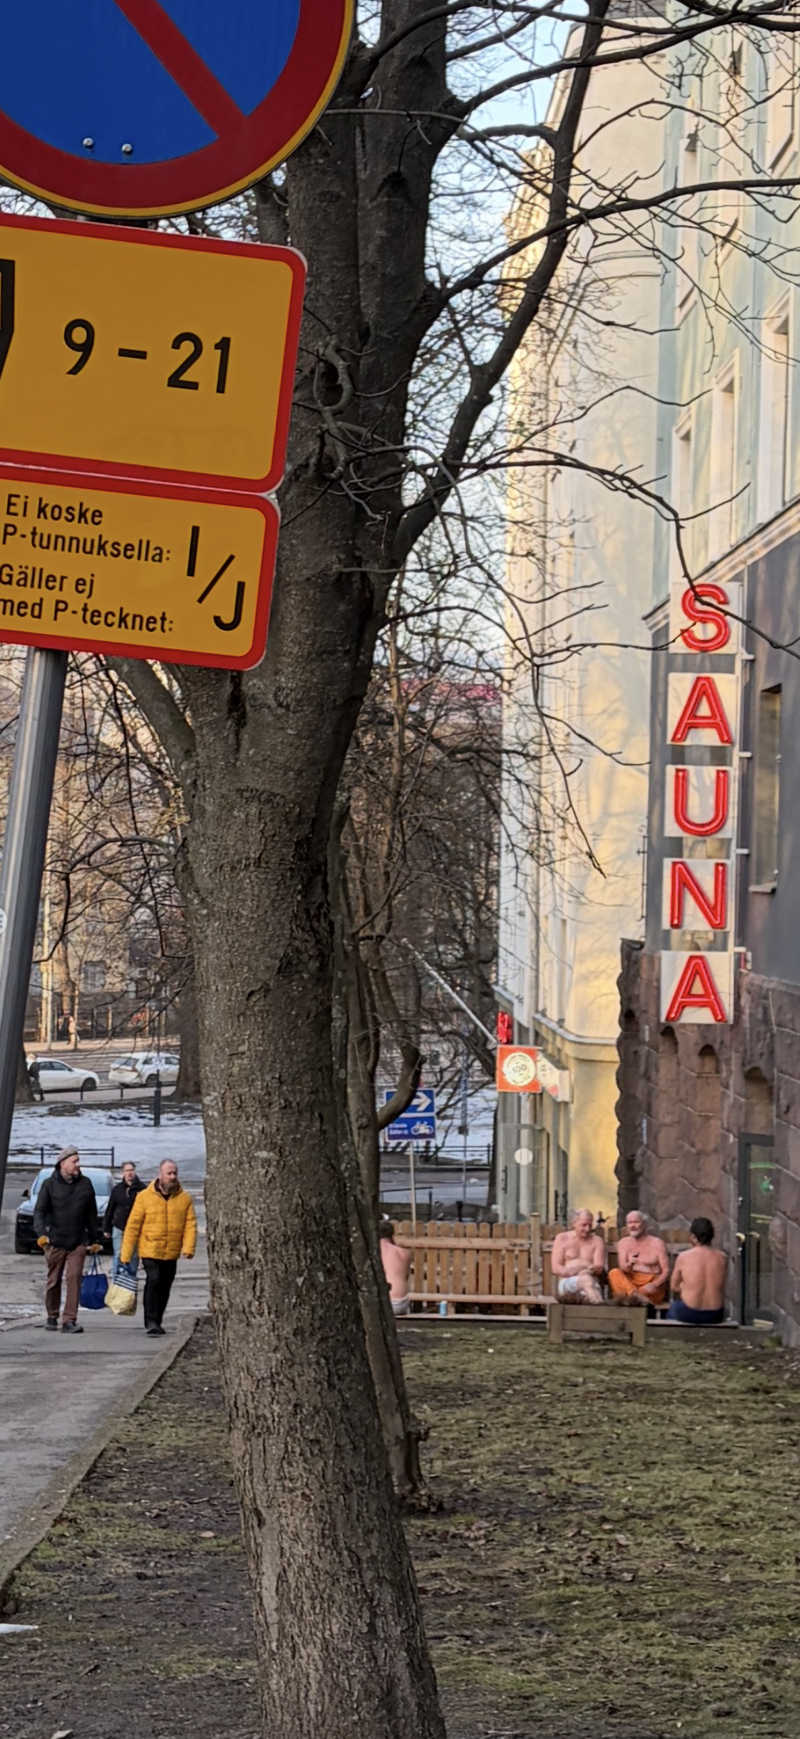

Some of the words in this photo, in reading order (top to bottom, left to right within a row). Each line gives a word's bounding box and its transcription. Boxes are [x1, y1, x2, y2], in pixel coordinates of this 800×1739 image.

[63, 318, 95, 376] 9
[166, 331, 231, 394] 21
[6, 493, 29, 518] Ei
[36, 497, 104, 526] koske
[2, 523, 172, 563] P-tunnuksella:
[0, 563, 68, 592] Gäller
[74, 573, 95, 599] ej
[53, 599, 174, 633] P-tecknet:
[665, 583, 733, 1024] SAUNA
